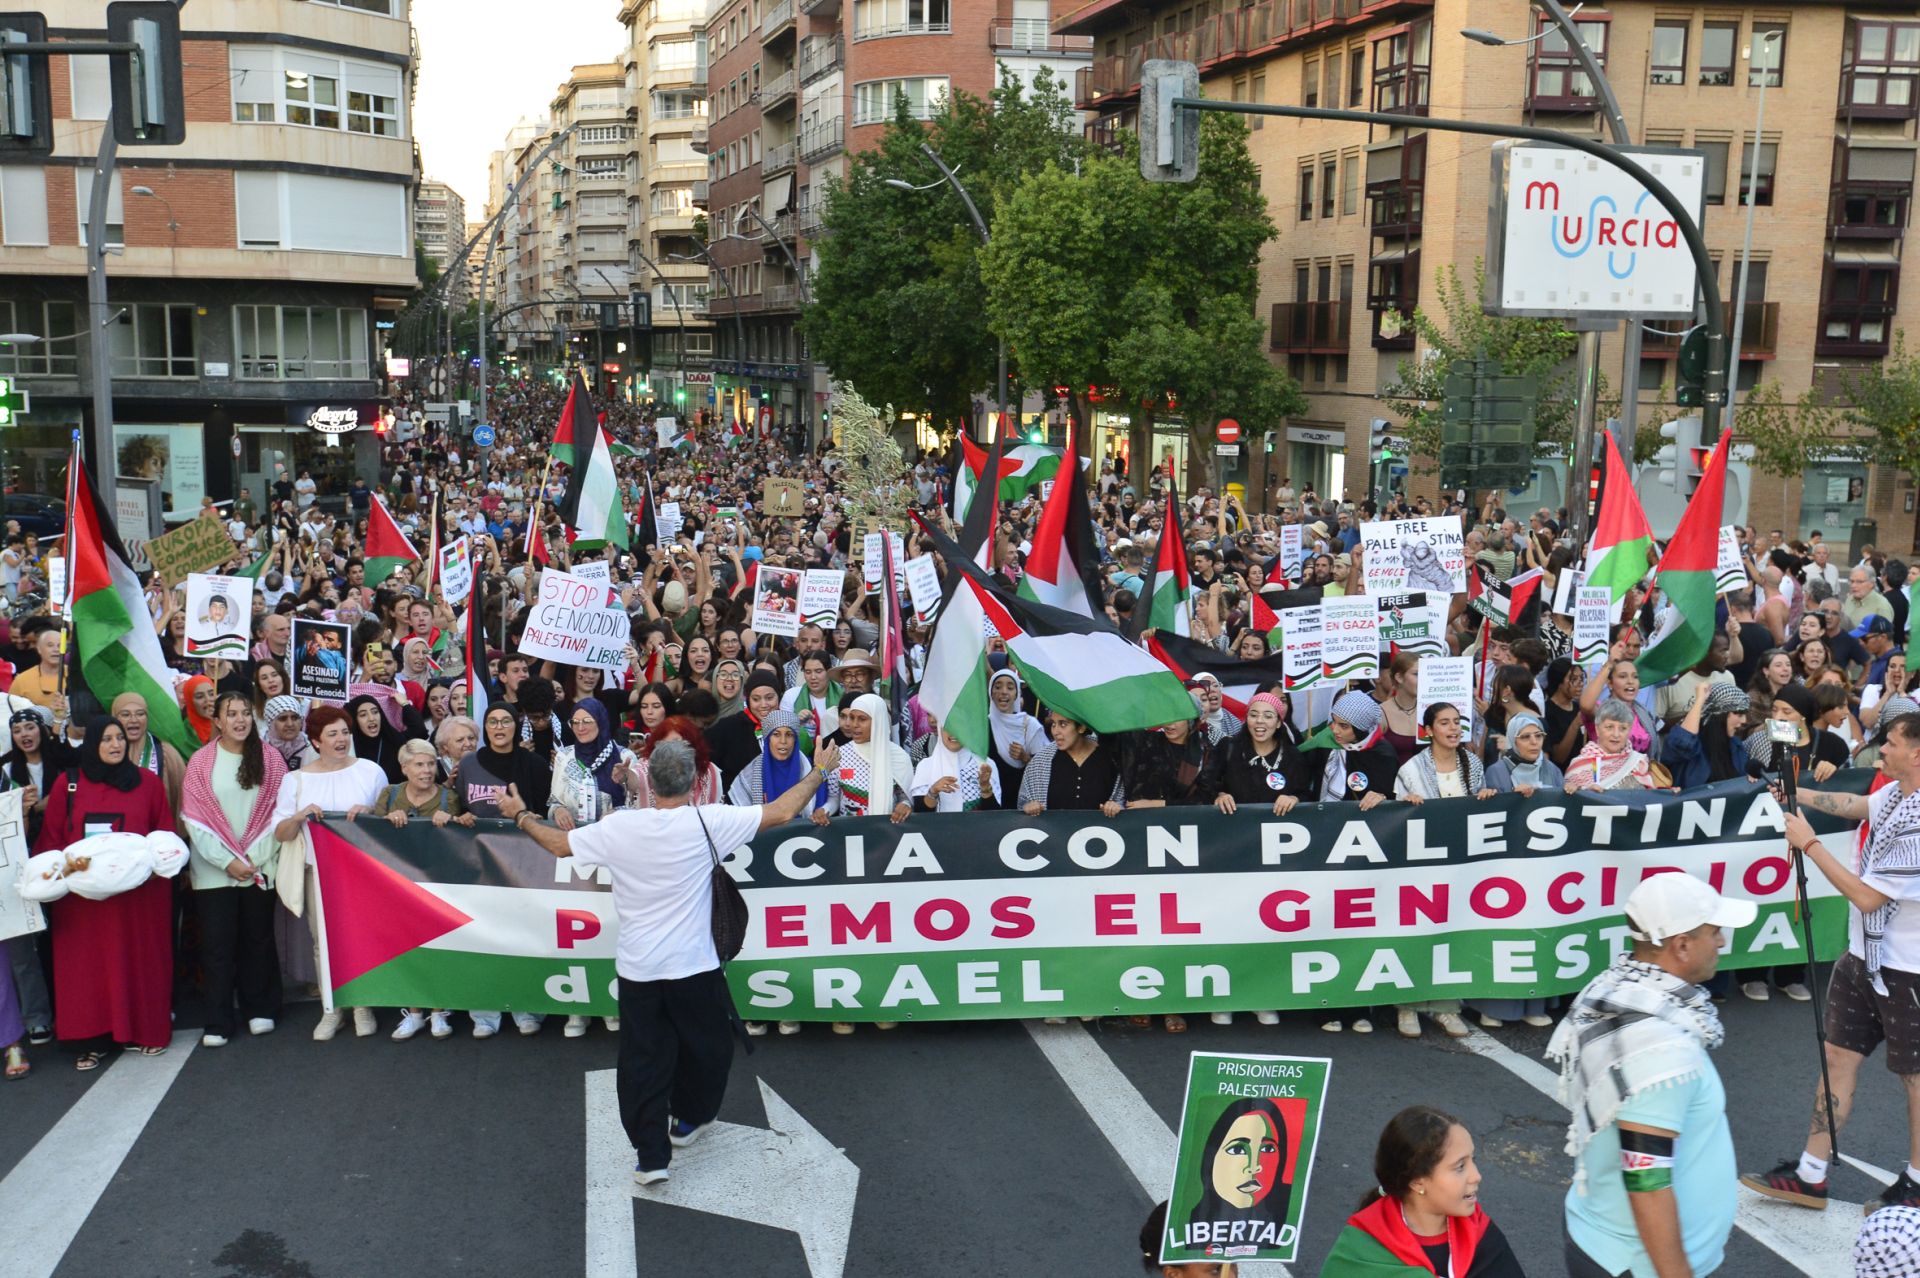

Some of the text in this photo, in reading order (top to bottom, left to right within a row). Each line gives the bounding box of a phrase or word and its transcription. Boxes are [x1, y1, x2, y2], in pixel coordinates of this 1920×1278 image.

[772, 504, 793, 512] LIBRE
[1395, 521, 1429, 535] FREE
[151, 517, 218, 556] EUROPA
[156, 531, 224, 571] COMPLICE
[175, 541, 234, 578] COBARDE
[1484, 571, 1501, 589] FREE
[544, 576, 599, 609] STOP
[806, 585, 840, 593] EN GAZA
[1582, 590, 1606, 598] MURCIA
[1380, 595, 1410, 607] FREE
[1579, 598, 1609, 606] PALESTINA
[1473, 598, 1506, 627] PALESTINE
[1325, 620, 1376, 631] EN GAZA
[1324, 635, 1375, 645] QUE PAGUEN
[1379, 626, 1426, 640] ALESTINE
[1325, 645, 1349, 653] ISRAEL
[302, 665, 340, 678] ASESINATO
[295, 684, 346, 698] Israel Genocida
[1427, 685, 1460, 693] EXIGIMOS
[998, 824, 1200, 872] CON
[1260, 792, 1787, 866] PALESTINA
[556, 856, 1791, 950] PEMOS EL GENOCIIO
[544, 965, 619, 1004] d
[747, 959, 1065, 1009] SRAEL
[1119, 964, 1231, 1000] en
[1217, 1062, 1304, 1079] PRISIONERAS
[1217, 1082, 1296, 1098] PALESTINAS
[1168, 1219, 1298, 1249] LIBERTAD
